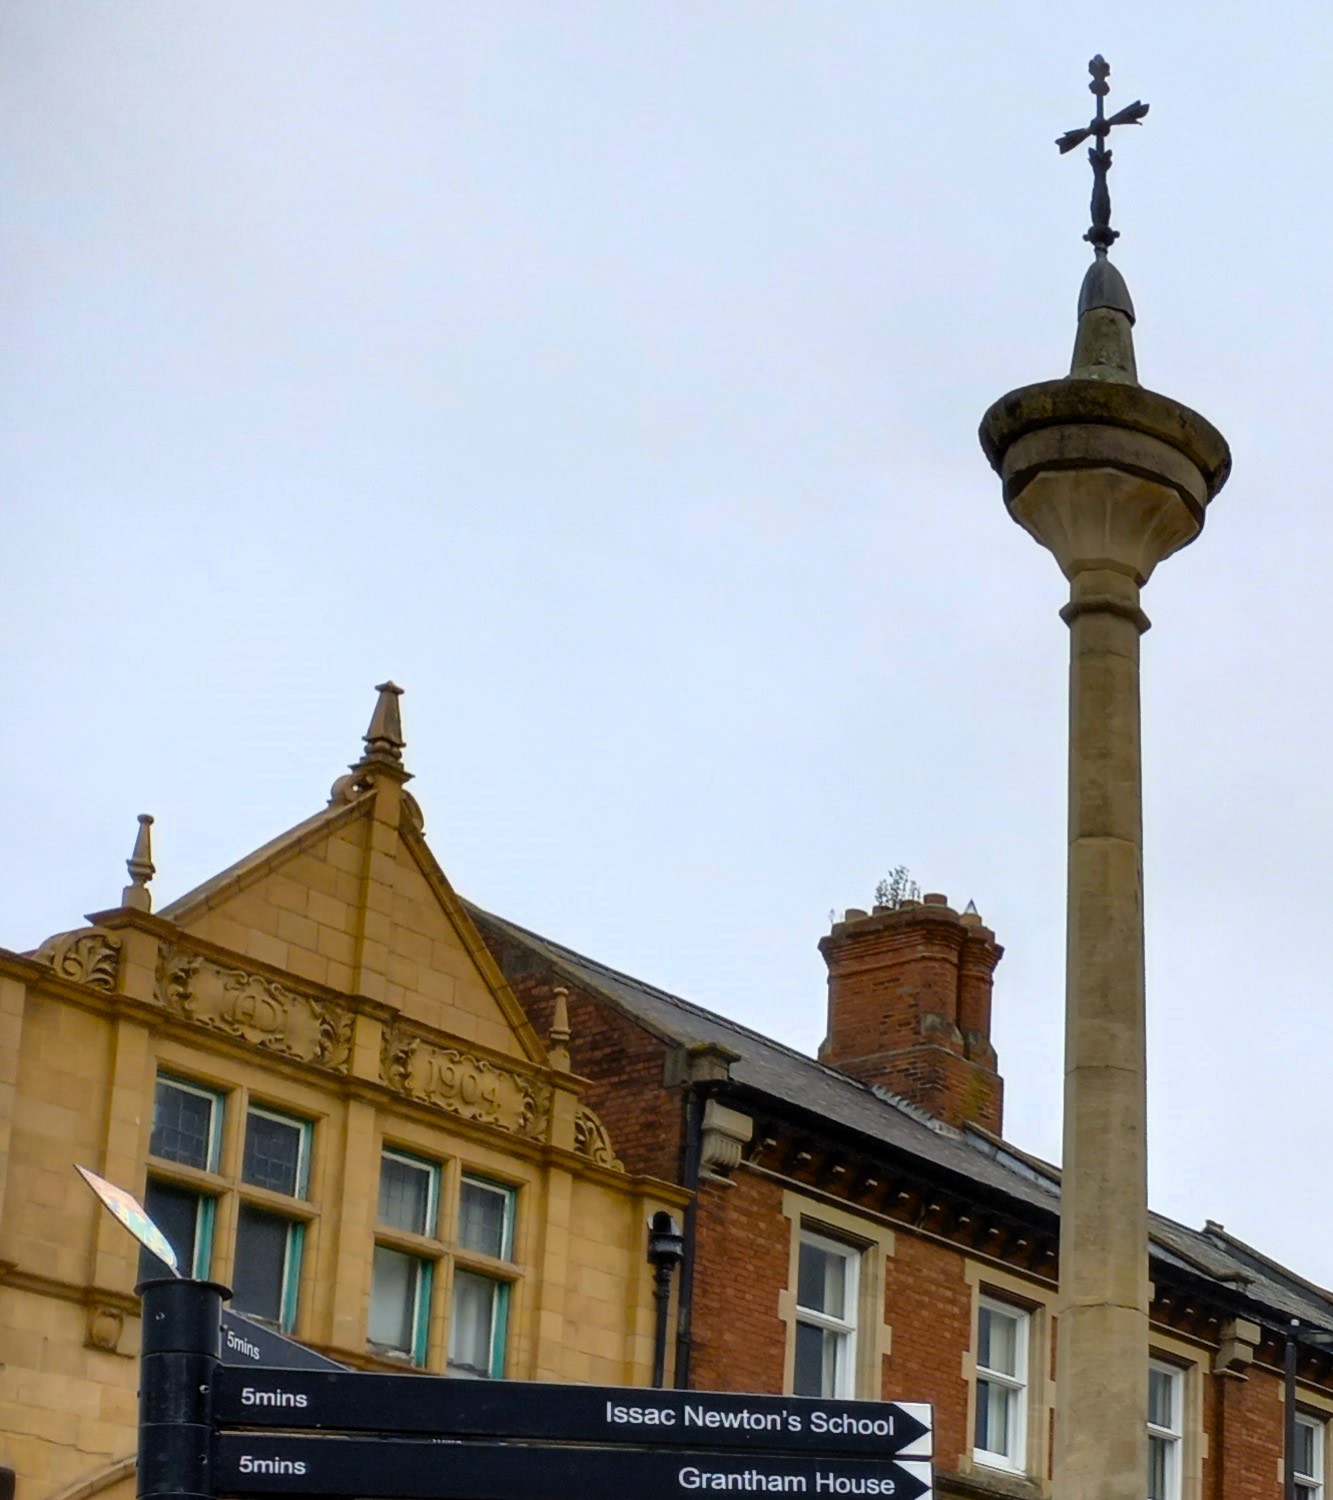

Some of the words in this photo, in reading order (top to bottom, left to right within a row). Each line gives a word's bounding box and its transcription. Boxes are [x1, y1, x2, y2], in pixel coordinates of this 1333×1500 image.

[424, 1058, 501, 1115] 1904
[226, 1330, 261, 1361] 5mins
[240, 1387, 308, 1408] 5mins
[605, 1401, 676, 1426] Issac
[683, 1404, 802, 1433] Newton's
[809, 1411, 895, 1435] School
[238, 1455, 307, 1475] 5mins
[677, 1466, 807, 1493] Grantham
[815, 1472, 896, 1495] House
